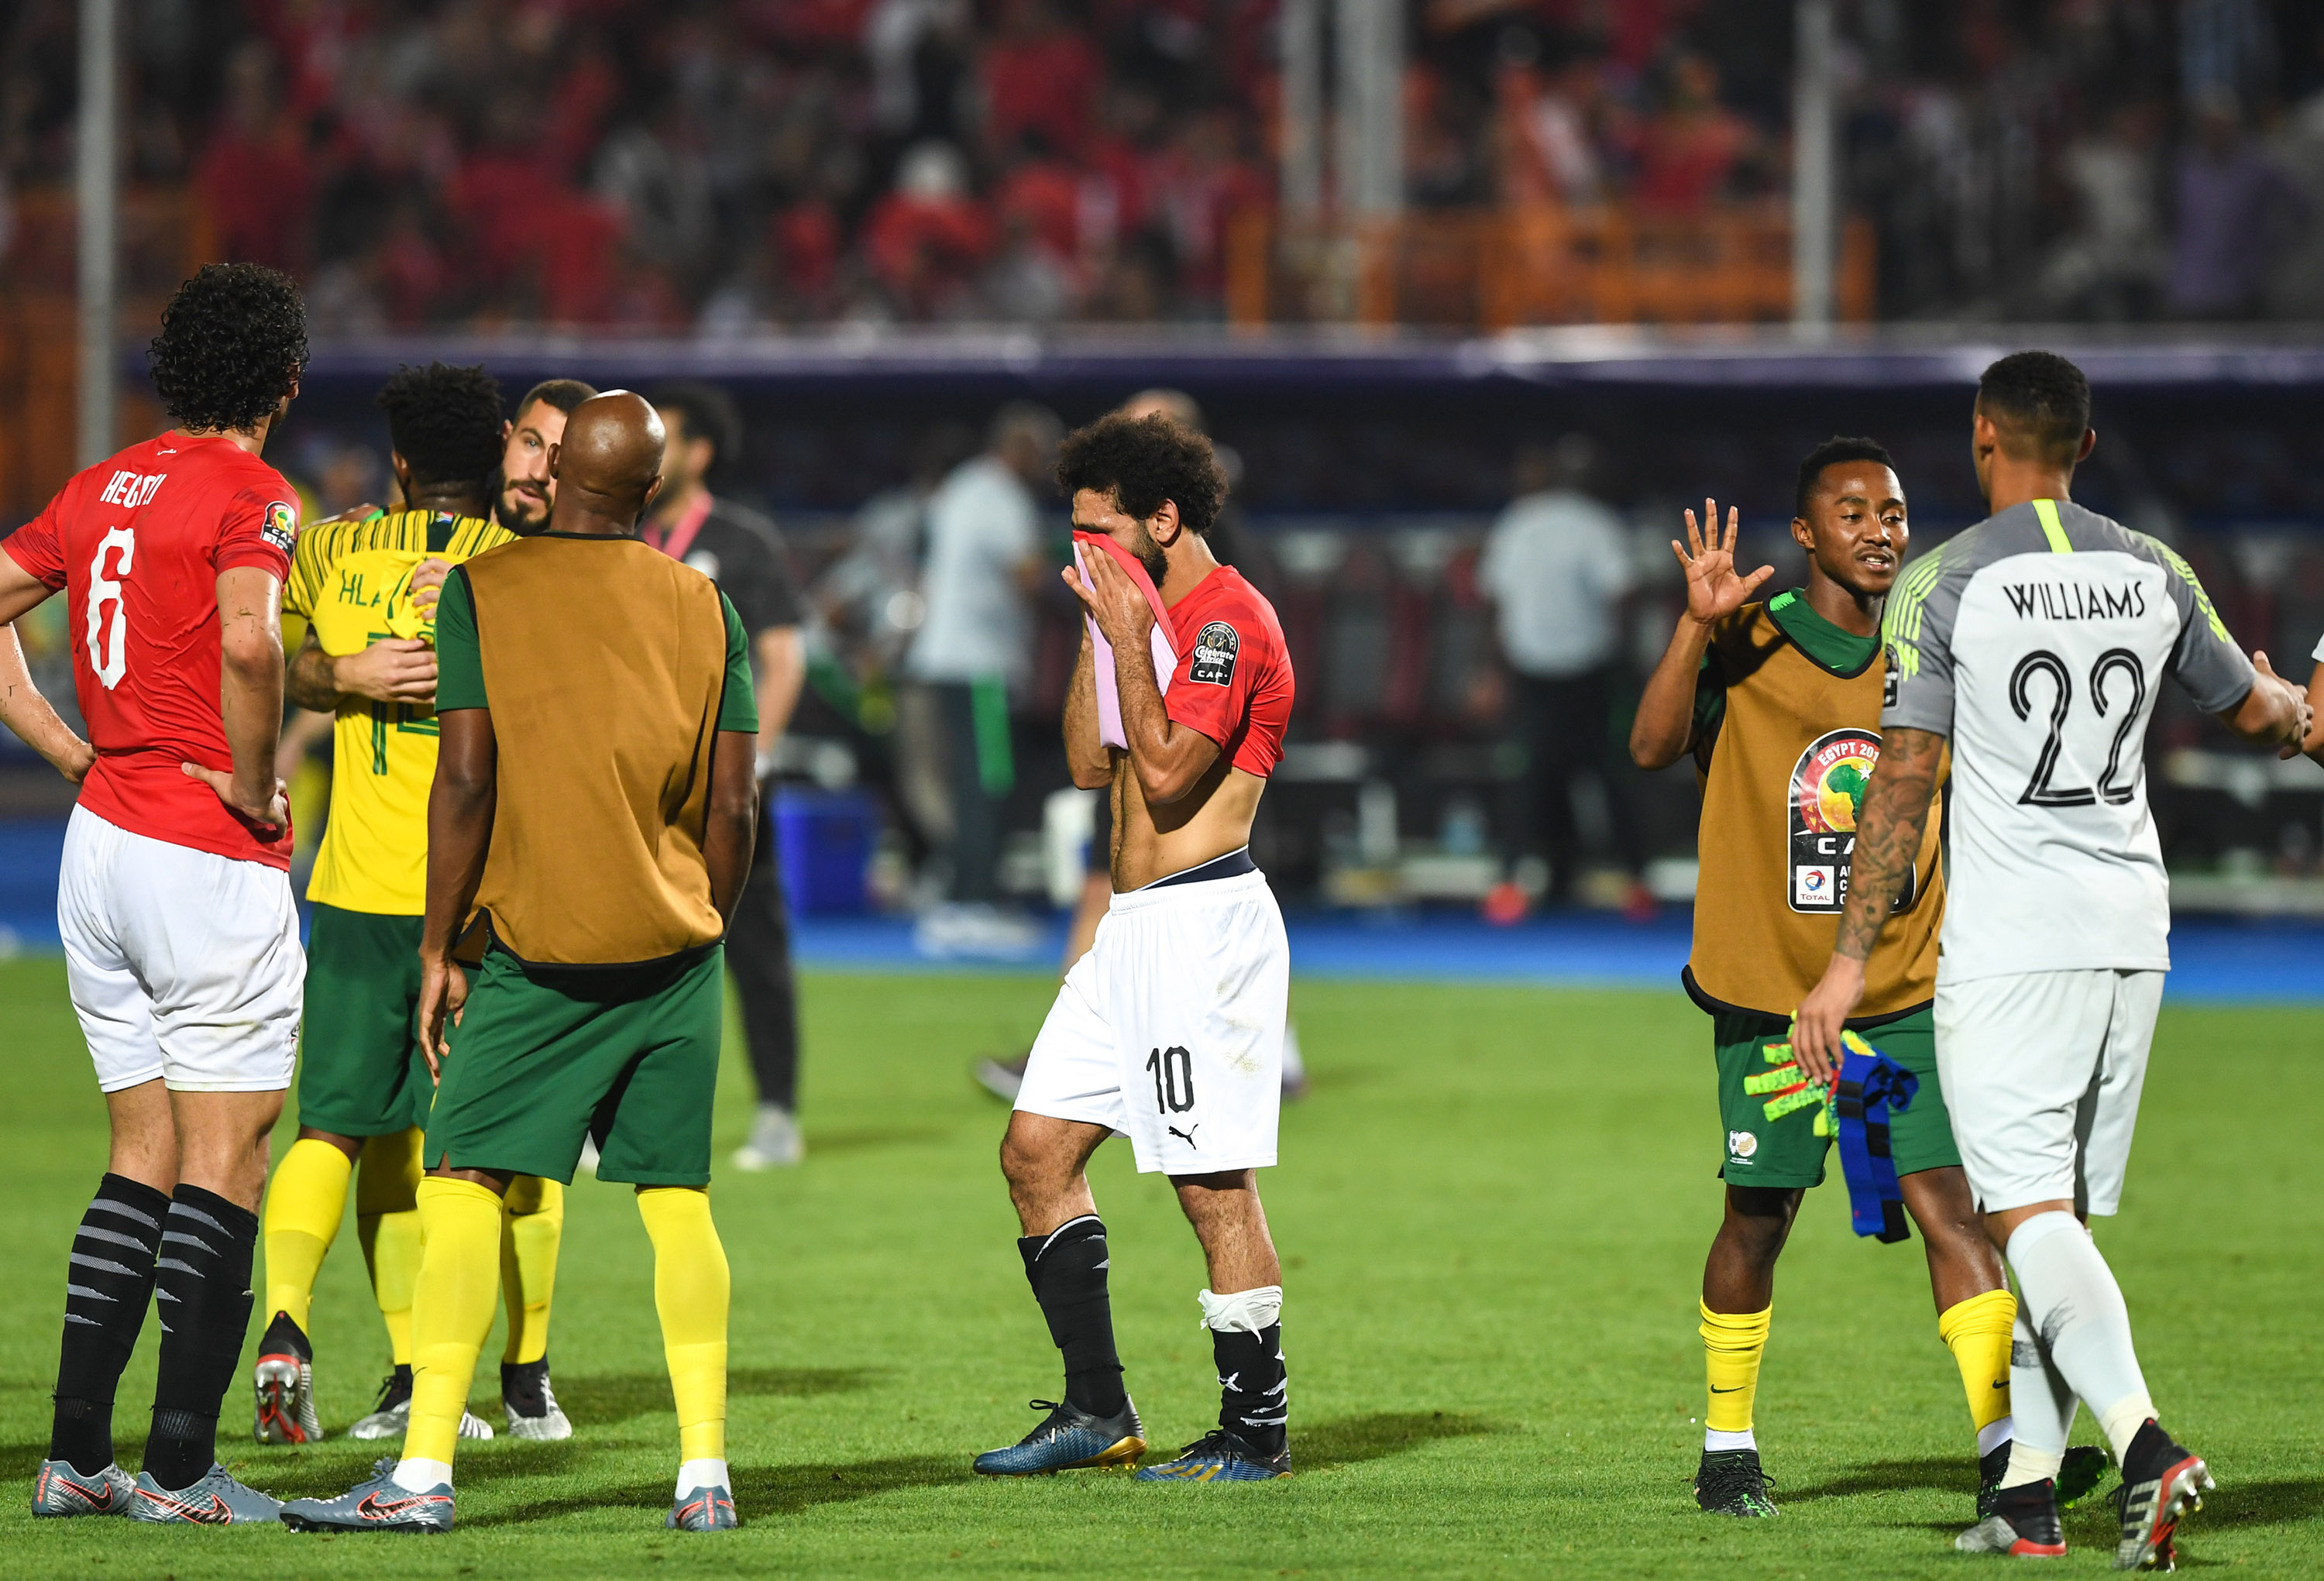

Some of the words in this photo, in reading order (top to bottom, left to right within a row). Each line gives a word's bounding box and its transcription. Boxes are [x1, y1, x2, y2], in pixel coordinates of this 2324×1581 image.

[86, 525, 135, 690] 6
[2003, 581, 2145, 620] WILLIAMS
[1195, 645, 1234, 661] Celebrate
[1200, 655, 1226, 664] Africa
[1197, 670, 1223, 679] CAF
[2009, 648, 2146, 807] 22
[1817, 741, 1856, 767] EGYPT
[1859, 744, 1880, 762] 201
[1817, 837, 1856, 854] CA
[1146, 1046, 1195, 1115] 10
